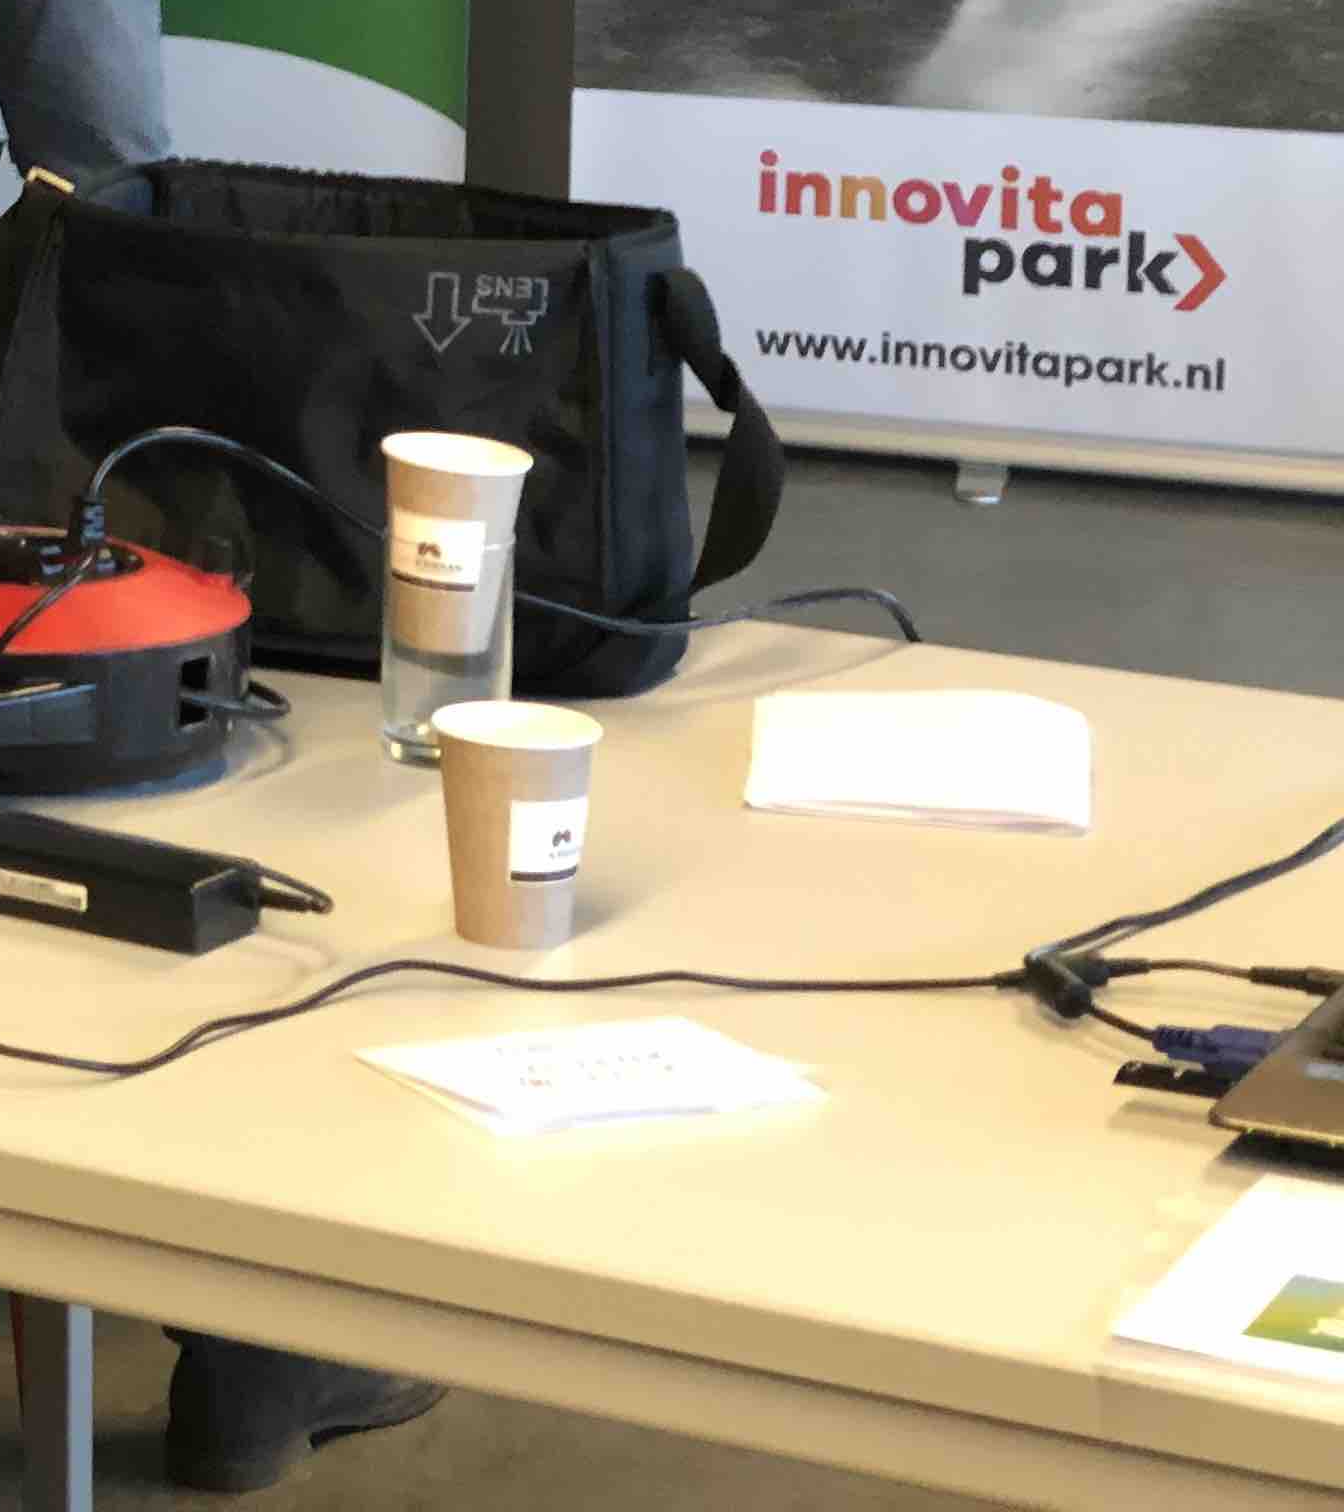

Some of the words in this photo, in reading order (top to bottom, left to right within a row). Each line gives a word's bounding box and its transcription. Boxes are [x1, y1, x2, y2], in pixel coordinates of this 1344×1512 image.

[759, 149, 1123, 238] innovita
[962, 231, 1180, 296] park
[756, 327, 1226, 392] www.innovitapark.nl
